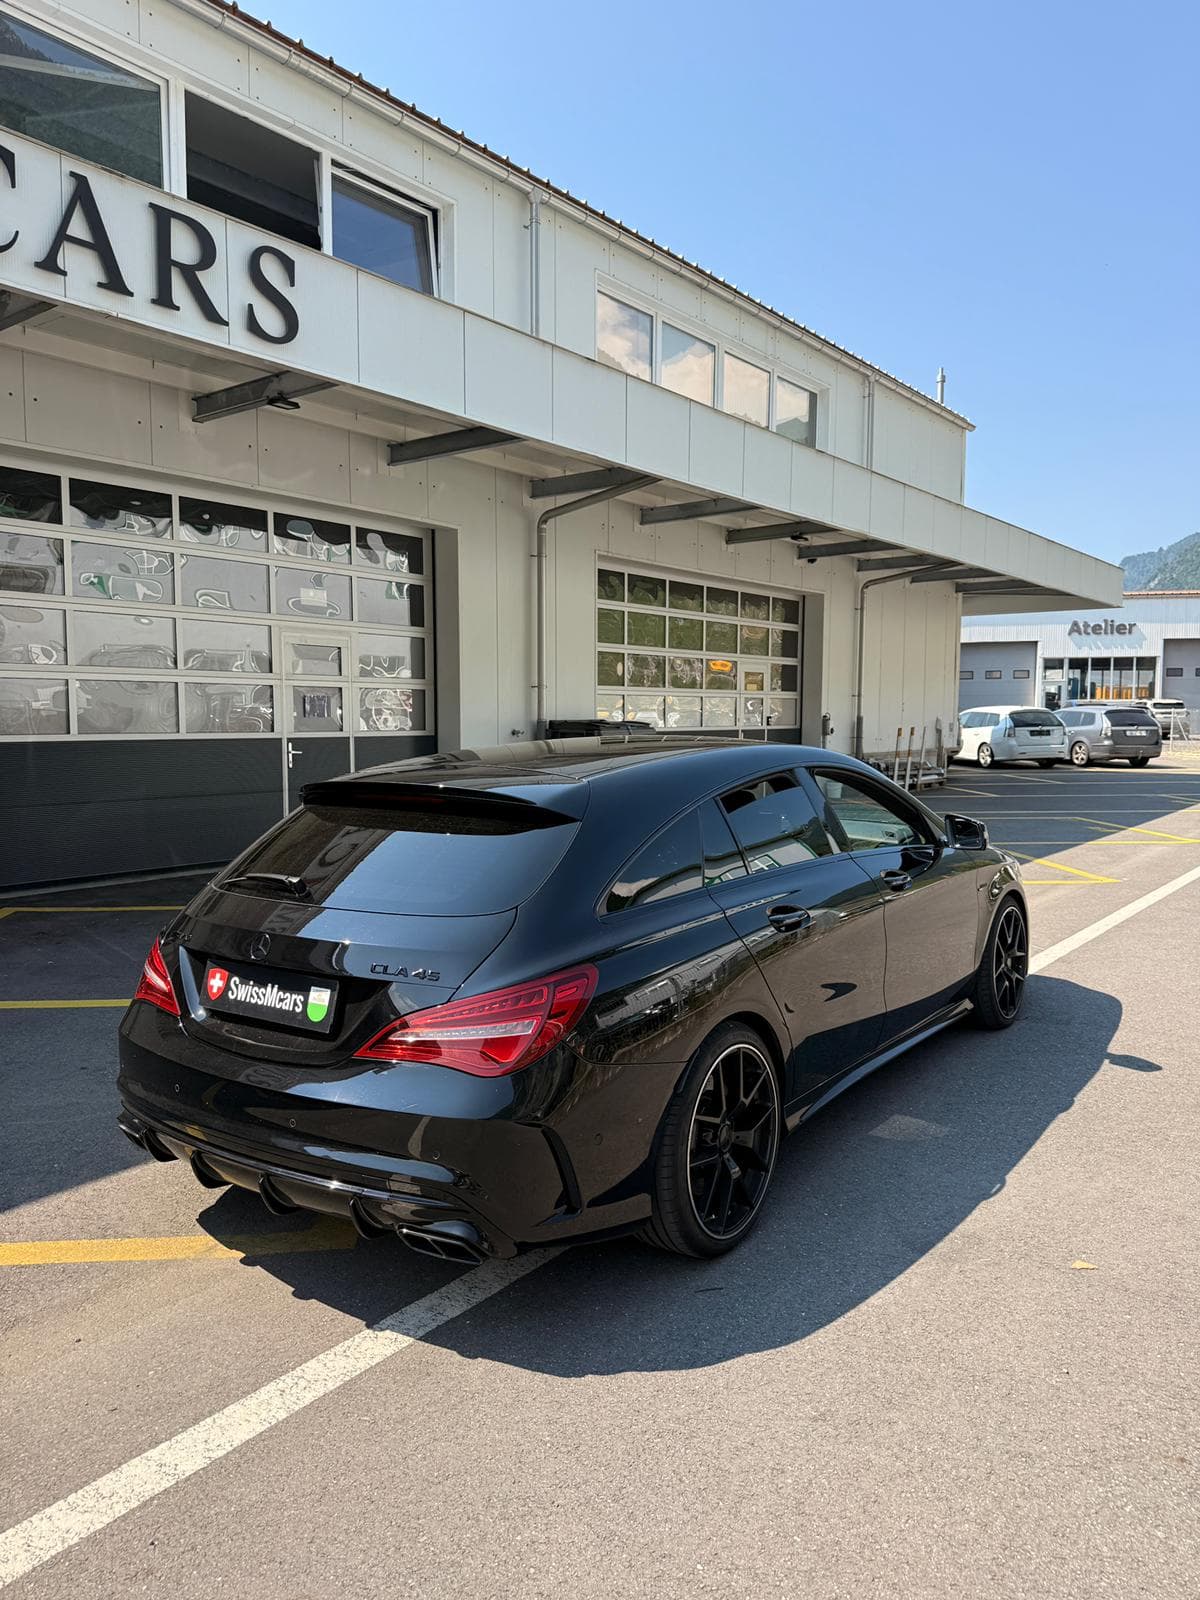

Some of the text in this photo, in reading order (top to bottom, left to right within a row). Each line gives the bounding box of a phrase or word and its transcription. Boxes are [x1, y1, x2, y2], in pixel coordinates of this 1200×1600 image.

[1068, 619, 1137, 636] Atelier
[371, 963, 441, 982] CLA 45
[228, 976, 304, 1013] SwissMcars
